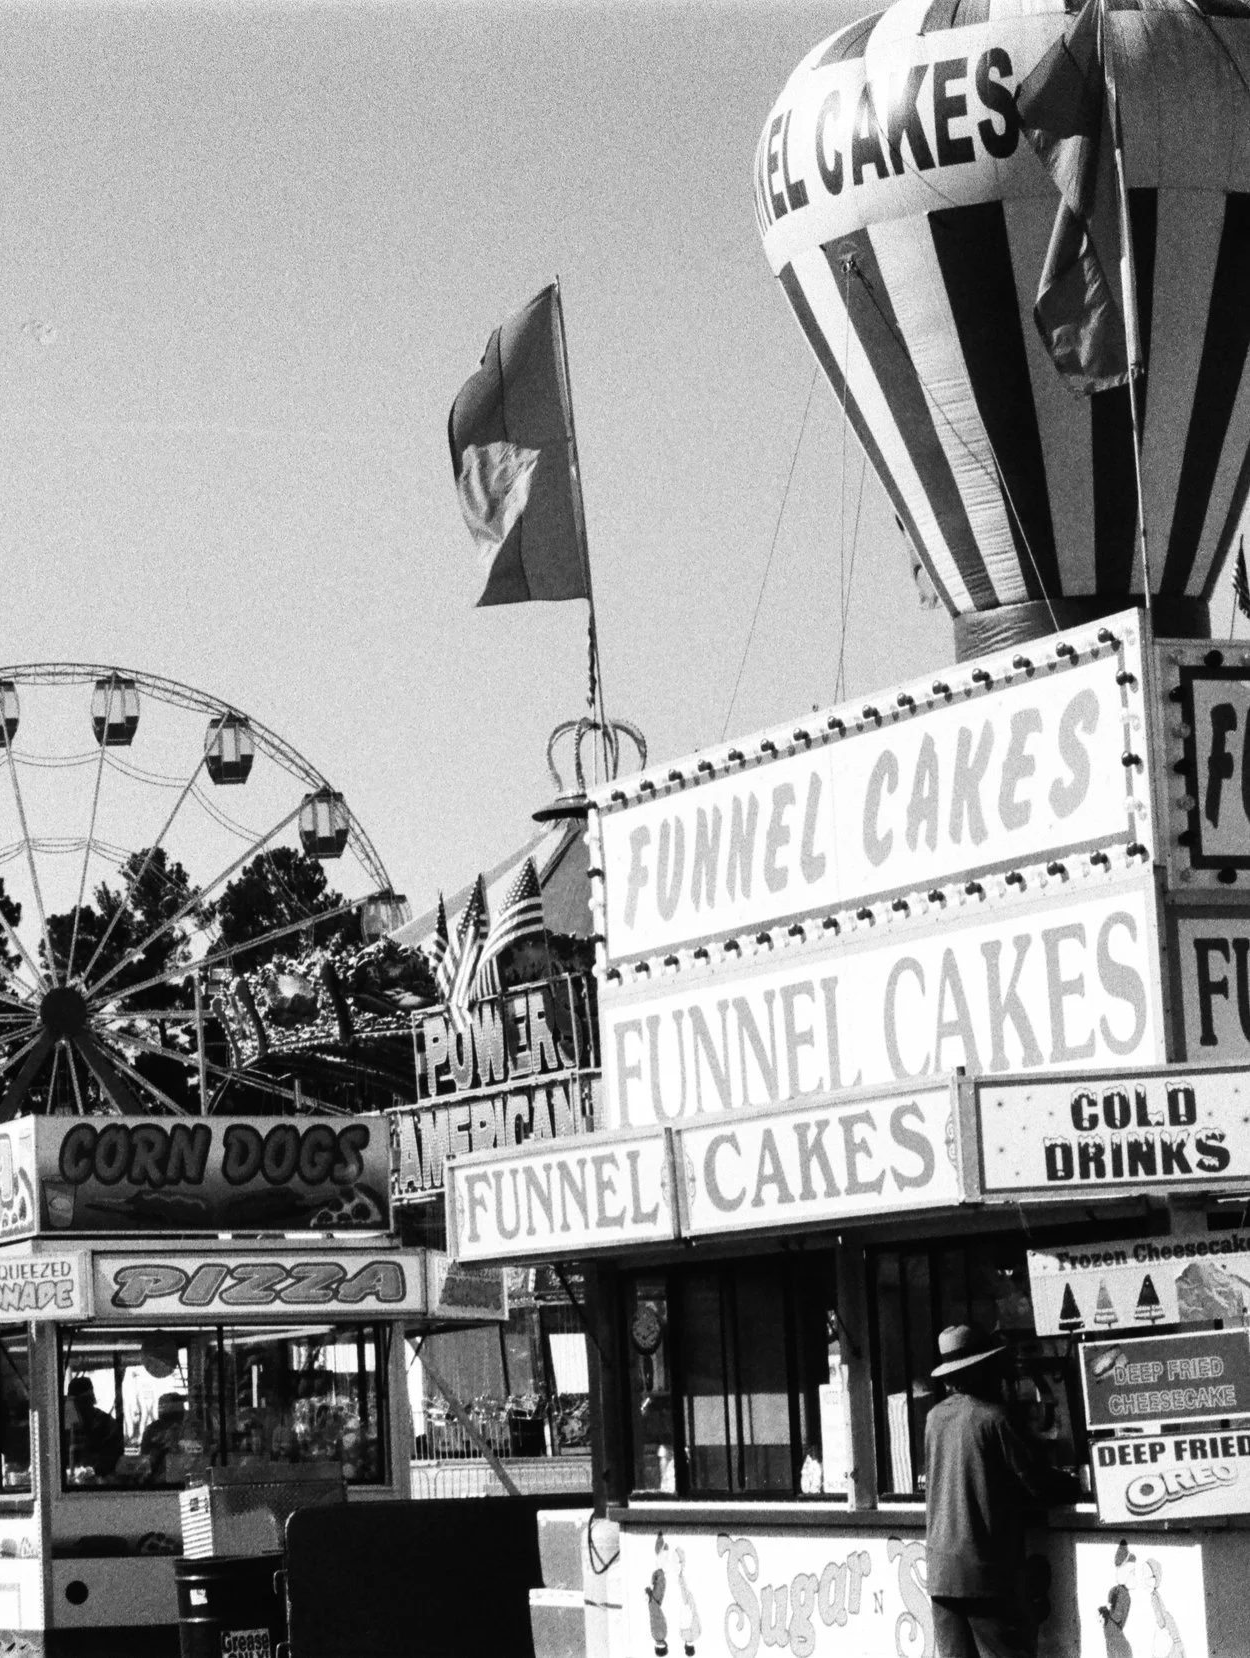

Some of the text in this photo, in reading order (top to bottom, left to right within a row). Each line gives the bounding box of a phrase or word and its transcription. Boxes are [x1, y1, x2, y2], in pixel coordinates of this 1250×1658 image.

[816, 47, 1023, 196] CAKES
[623, 687, 1100, 929] FUNNEL CAKES
[613, 910, 1148, 1128] FUNNEL CAKES
[1070, 1080, 1198, 1132] COLD
[59, 1122, 370, 1187] CORN DOGS
[466, 1101, 936, 1243] FUNNEL CAKES
[1043, 1127, 1231, 1181] DRINKS
[1057, 1241, 1128, 1273] Frozen
[111, 1261, 407, 1308] PIZZA
[1114, 1355, 1225, 1387] DEEP FRIED
[1108, 1384, 1238, 1417] CHEESECAKE
[1098, 1434, 1250, 1469] DEEP FRIED
[1125, 1461, 1240, 1517] OREO
[716, 1533, 872, 1658] Sugar
[223, 1631, 269, 1653] Grease
